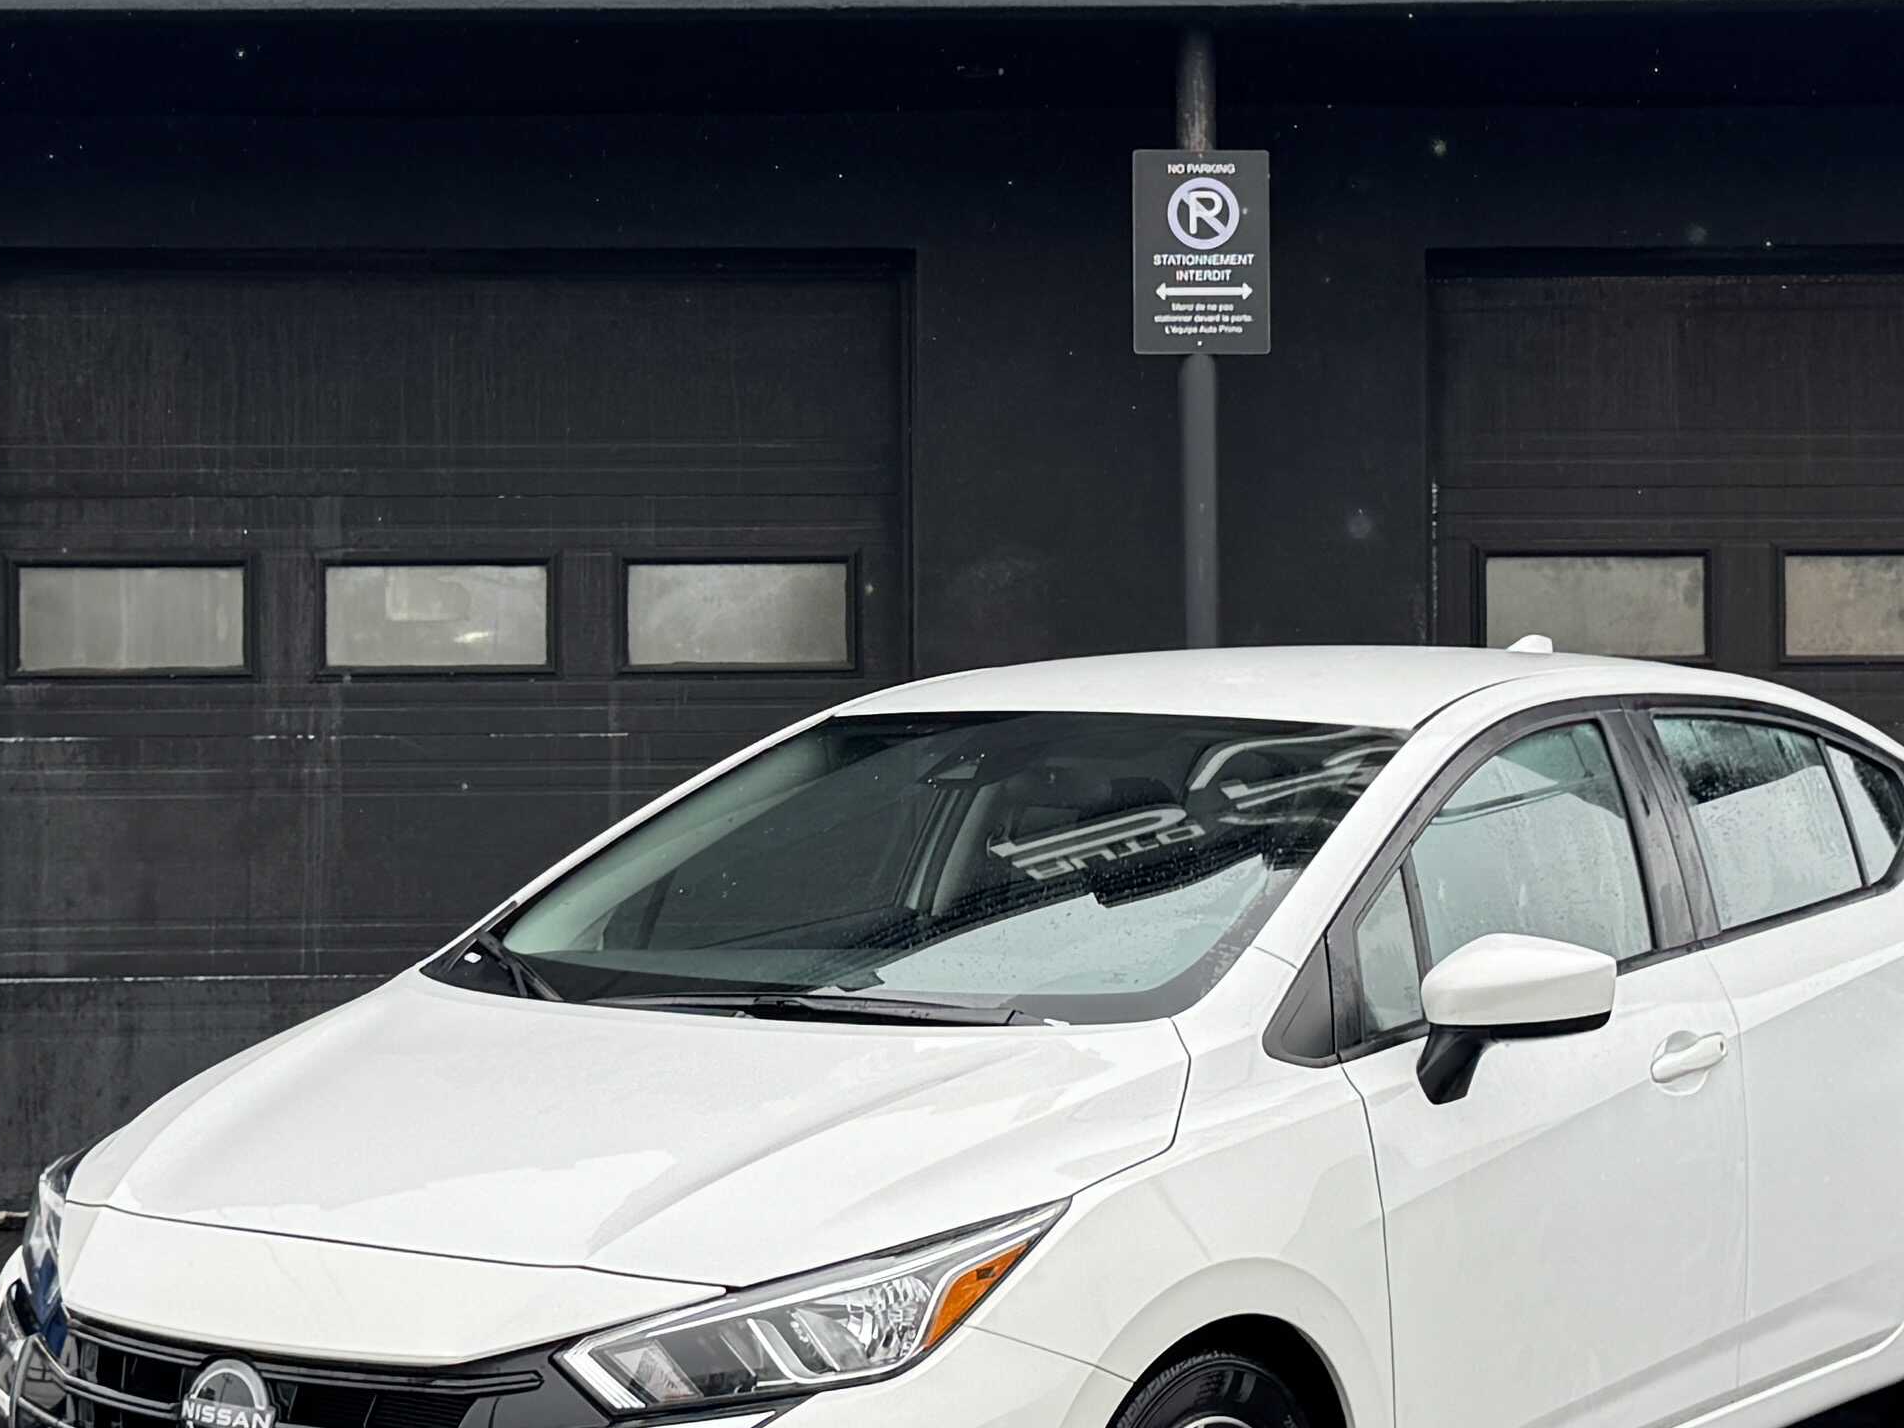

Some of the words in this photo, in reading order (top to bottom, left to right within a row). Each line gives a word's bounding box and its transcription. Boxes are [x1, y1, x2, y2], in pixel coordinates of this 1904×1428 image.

[1167, 163, 1185, 174] NO
[1187, 163, 1236, 174] PARKING
[1153, 254, 1255, 266] STATIONNEMENT
[1176, 270, 1232, 282] INTERDIT
